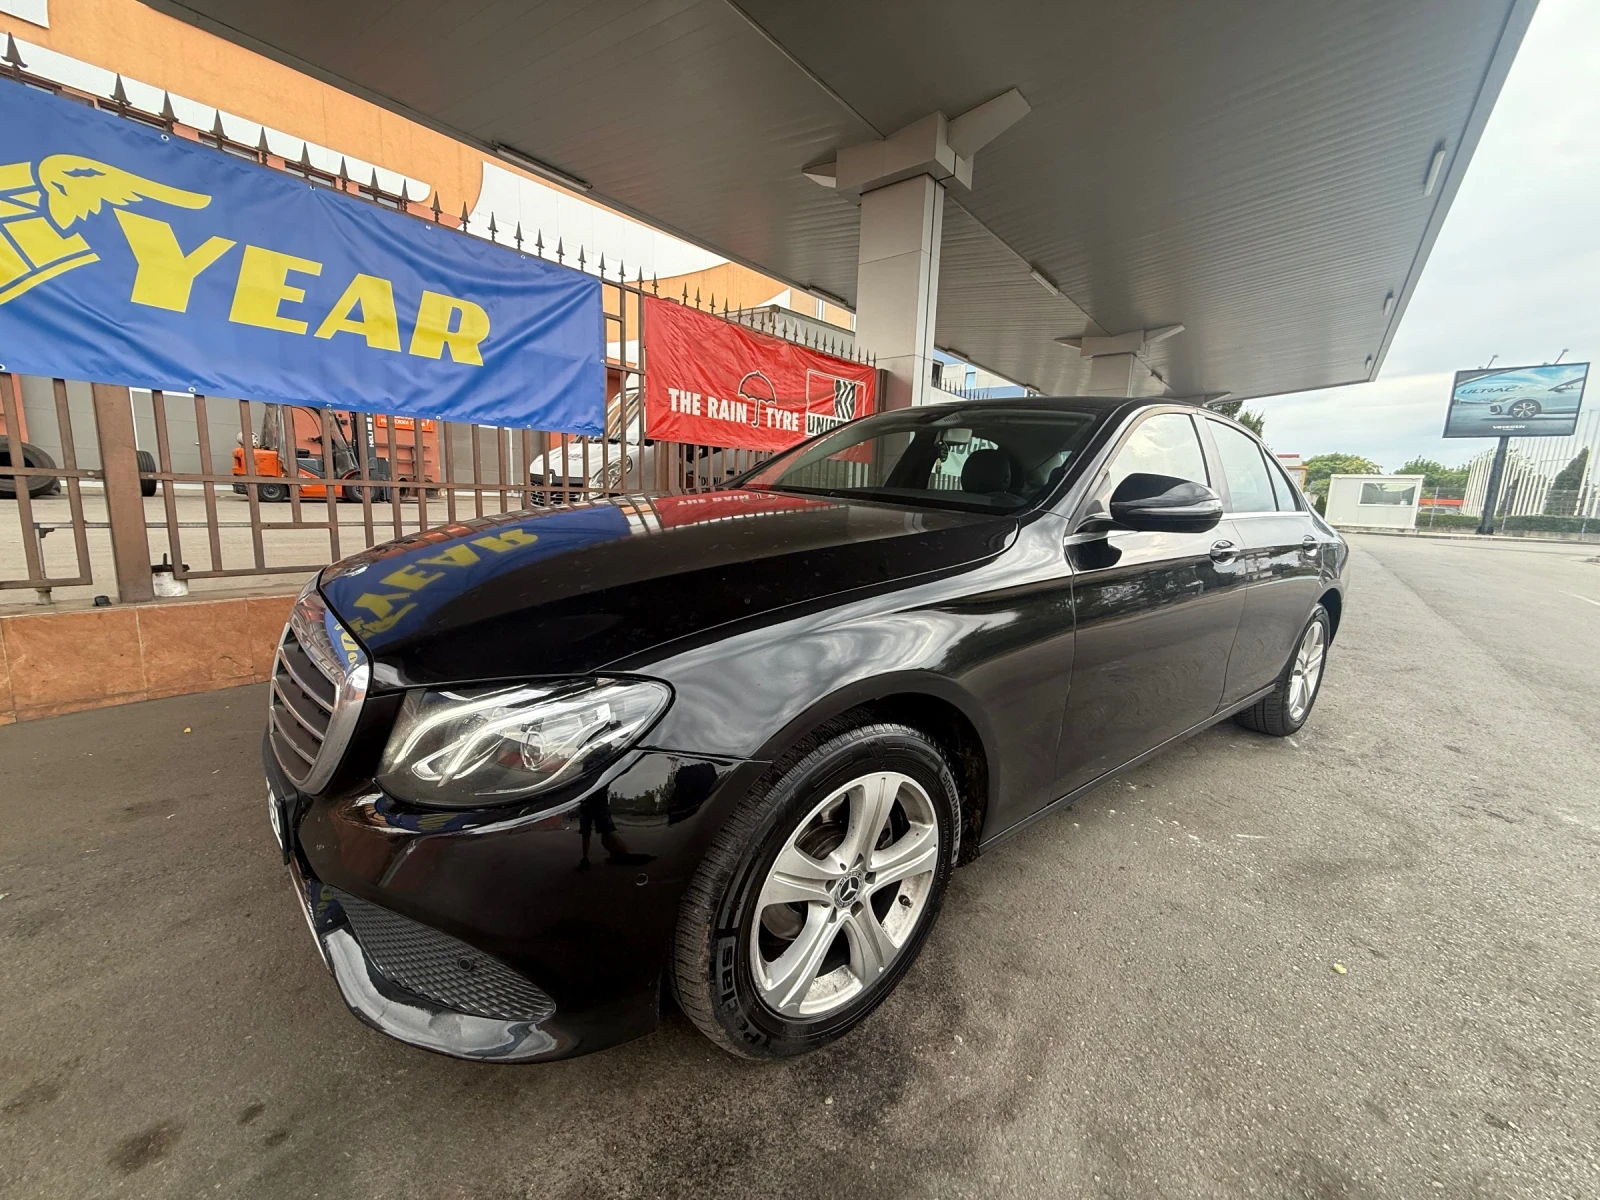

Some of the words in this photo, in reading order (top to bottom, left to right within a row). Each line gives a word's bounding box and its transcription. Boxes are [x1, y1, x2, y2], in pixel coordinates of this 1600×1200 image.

[113, 208, 491, 366] YEAR
[668, 387, 701, 416] THE
[707, 396, 747, 424] RAIN
[765, 407, 799, 432] TYRE
